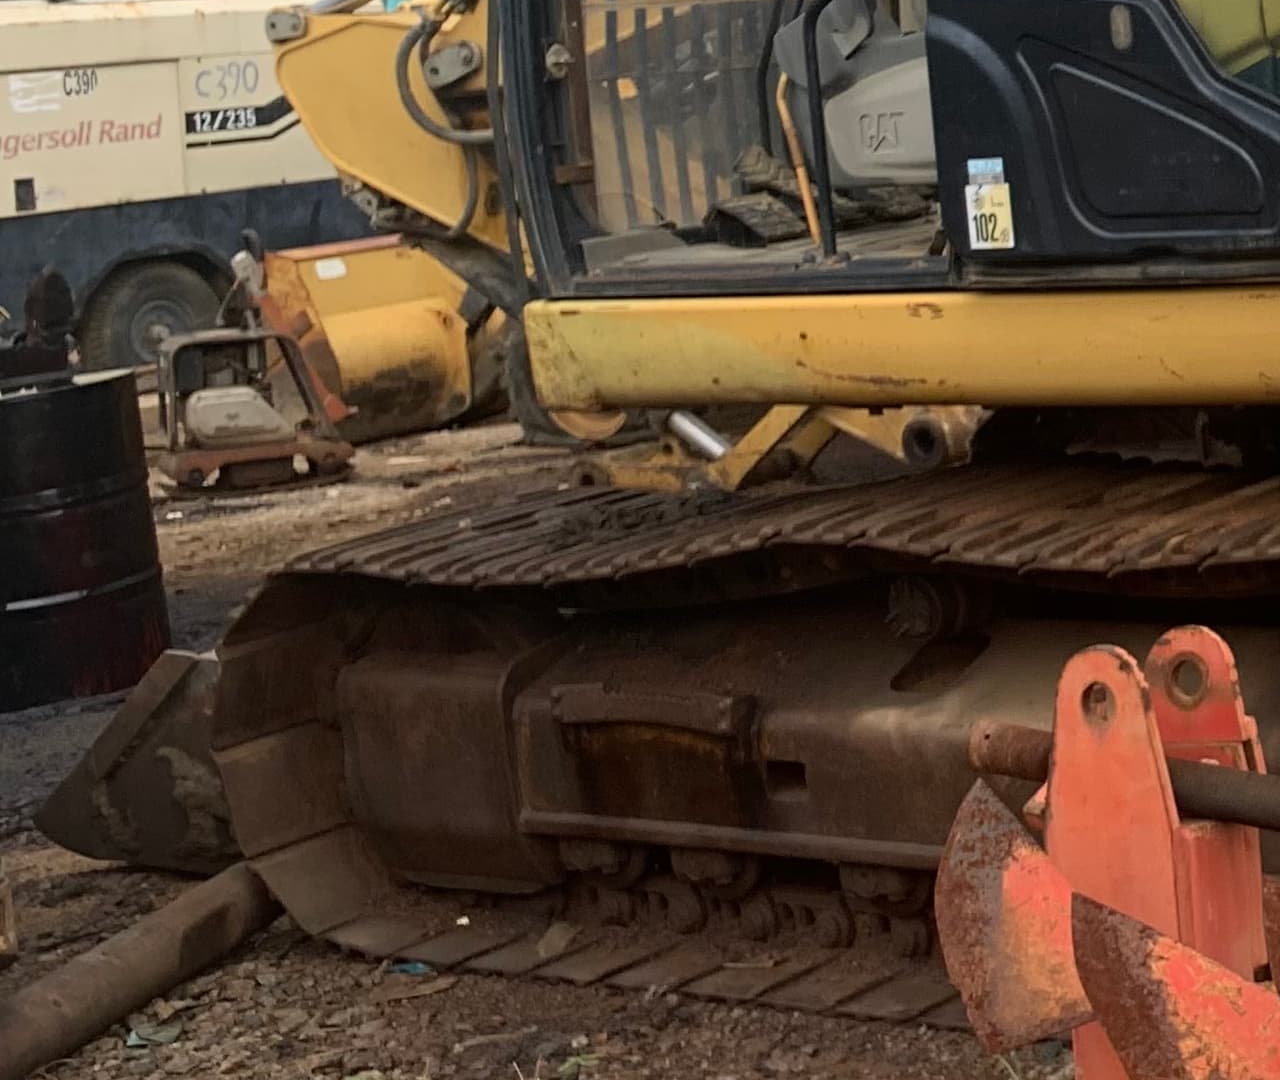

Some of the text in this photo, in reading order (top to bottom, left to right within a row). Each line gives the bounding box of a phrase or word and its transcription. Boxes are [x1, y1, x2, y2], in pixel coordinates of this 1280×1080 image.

[194, 60, 260, 101] C390
[0, 112, 163, 160] gersoll Rand
[192, 107, 257, 132] 12/235
[859, 110, 905, 153] CAT
[973, 212, 999, 243] 102
